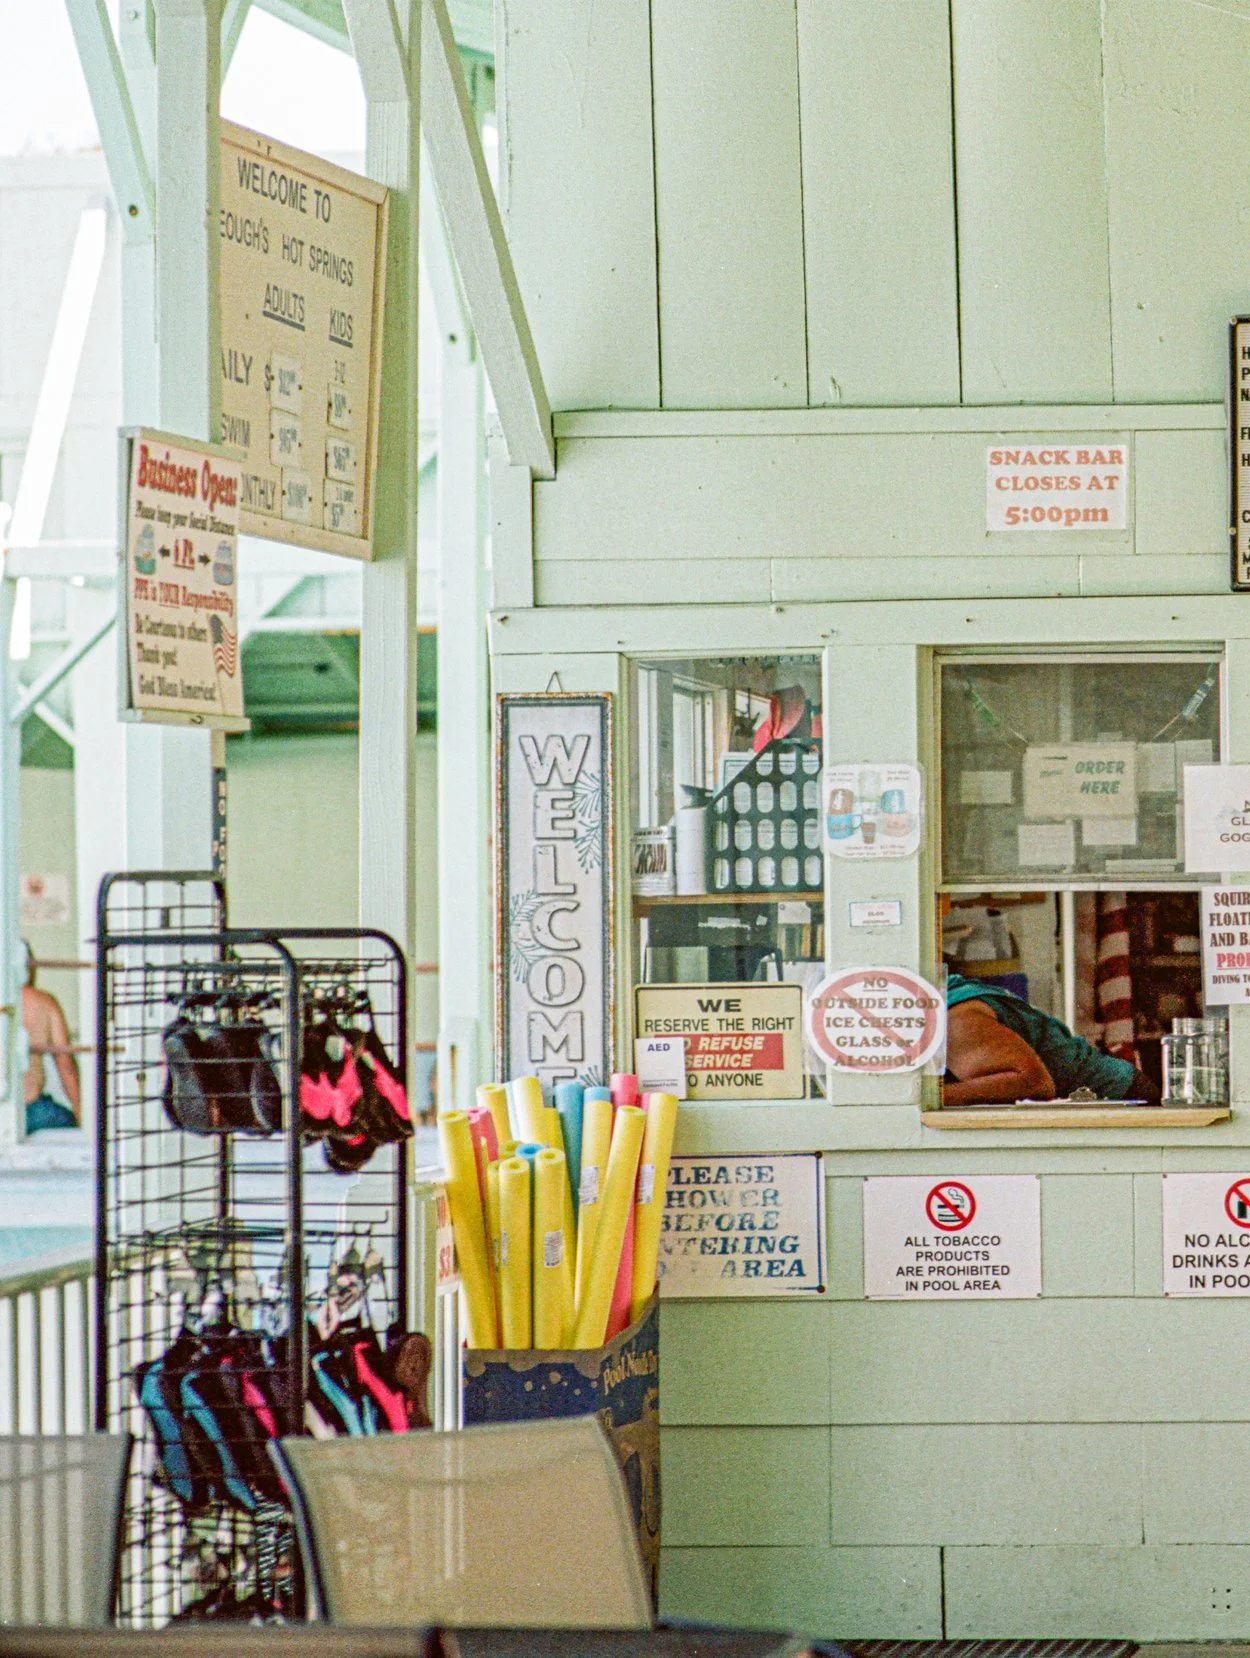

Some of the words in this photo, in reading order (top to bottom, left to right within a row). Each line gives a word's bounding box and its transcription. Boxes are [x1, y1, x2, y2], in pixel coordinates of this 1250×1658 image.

[237, 156, 307, 214] WELCOME
[314, 189, 331, 223] TO
[282, 233, 304, 266] HOT
[309, 245, 353, 287] SPRINGS
[263, 284, 305, 322] ADULTS
[330, 307, 352, 340] KIDS
[990, 450, 1070, 465] SNACK
[1076, 450, 1123, 464] BAR
[138, 444, 197, 498] Business
[1006, 506, 1109, 526] 5:00pm
[1075, 761, 1125, 774] ORDER
[1080, 780, 1120, 794] HERE
[863, 978, 887, 988] NO
[696, 999, 742, 1012] WE
[812, 998, 887, 1009] OUTSIDE
[893, 998, 939, 1009] FOOD
[644, 1018, 709, 1032] RESERVE
[719, 1018, 744, 1031] THE
[752, 1017, 794, 1031] RIGHT
[826, 1017, 855, 1028] ICE
[859, 1017, 925, 1028] CHESTS
[648, 1043, 670, 1051] AED
[834, 1055, 915, 1067] ALCOHOL
[705, 1073, 763, 1087] ANYONE
[668, 1166, 775, 1185] LEASE
[904, 1237, 929, 1246] ALL
[933, 1236, 1001, 1246] TOBACCO
[1185, 1234, 1210, 1247] NO
[916, 1251, 989, 1261] PRODUCTS
[1173, 1255, 1238, 1268] DRINKS
[721, 1259, 807, 1278] AREA
[896, 1266, 923, 1276] ARE
[928, 1266, 1010, 1276] PROHIBITED
[1190, 1276, 1205, 1288] IN
